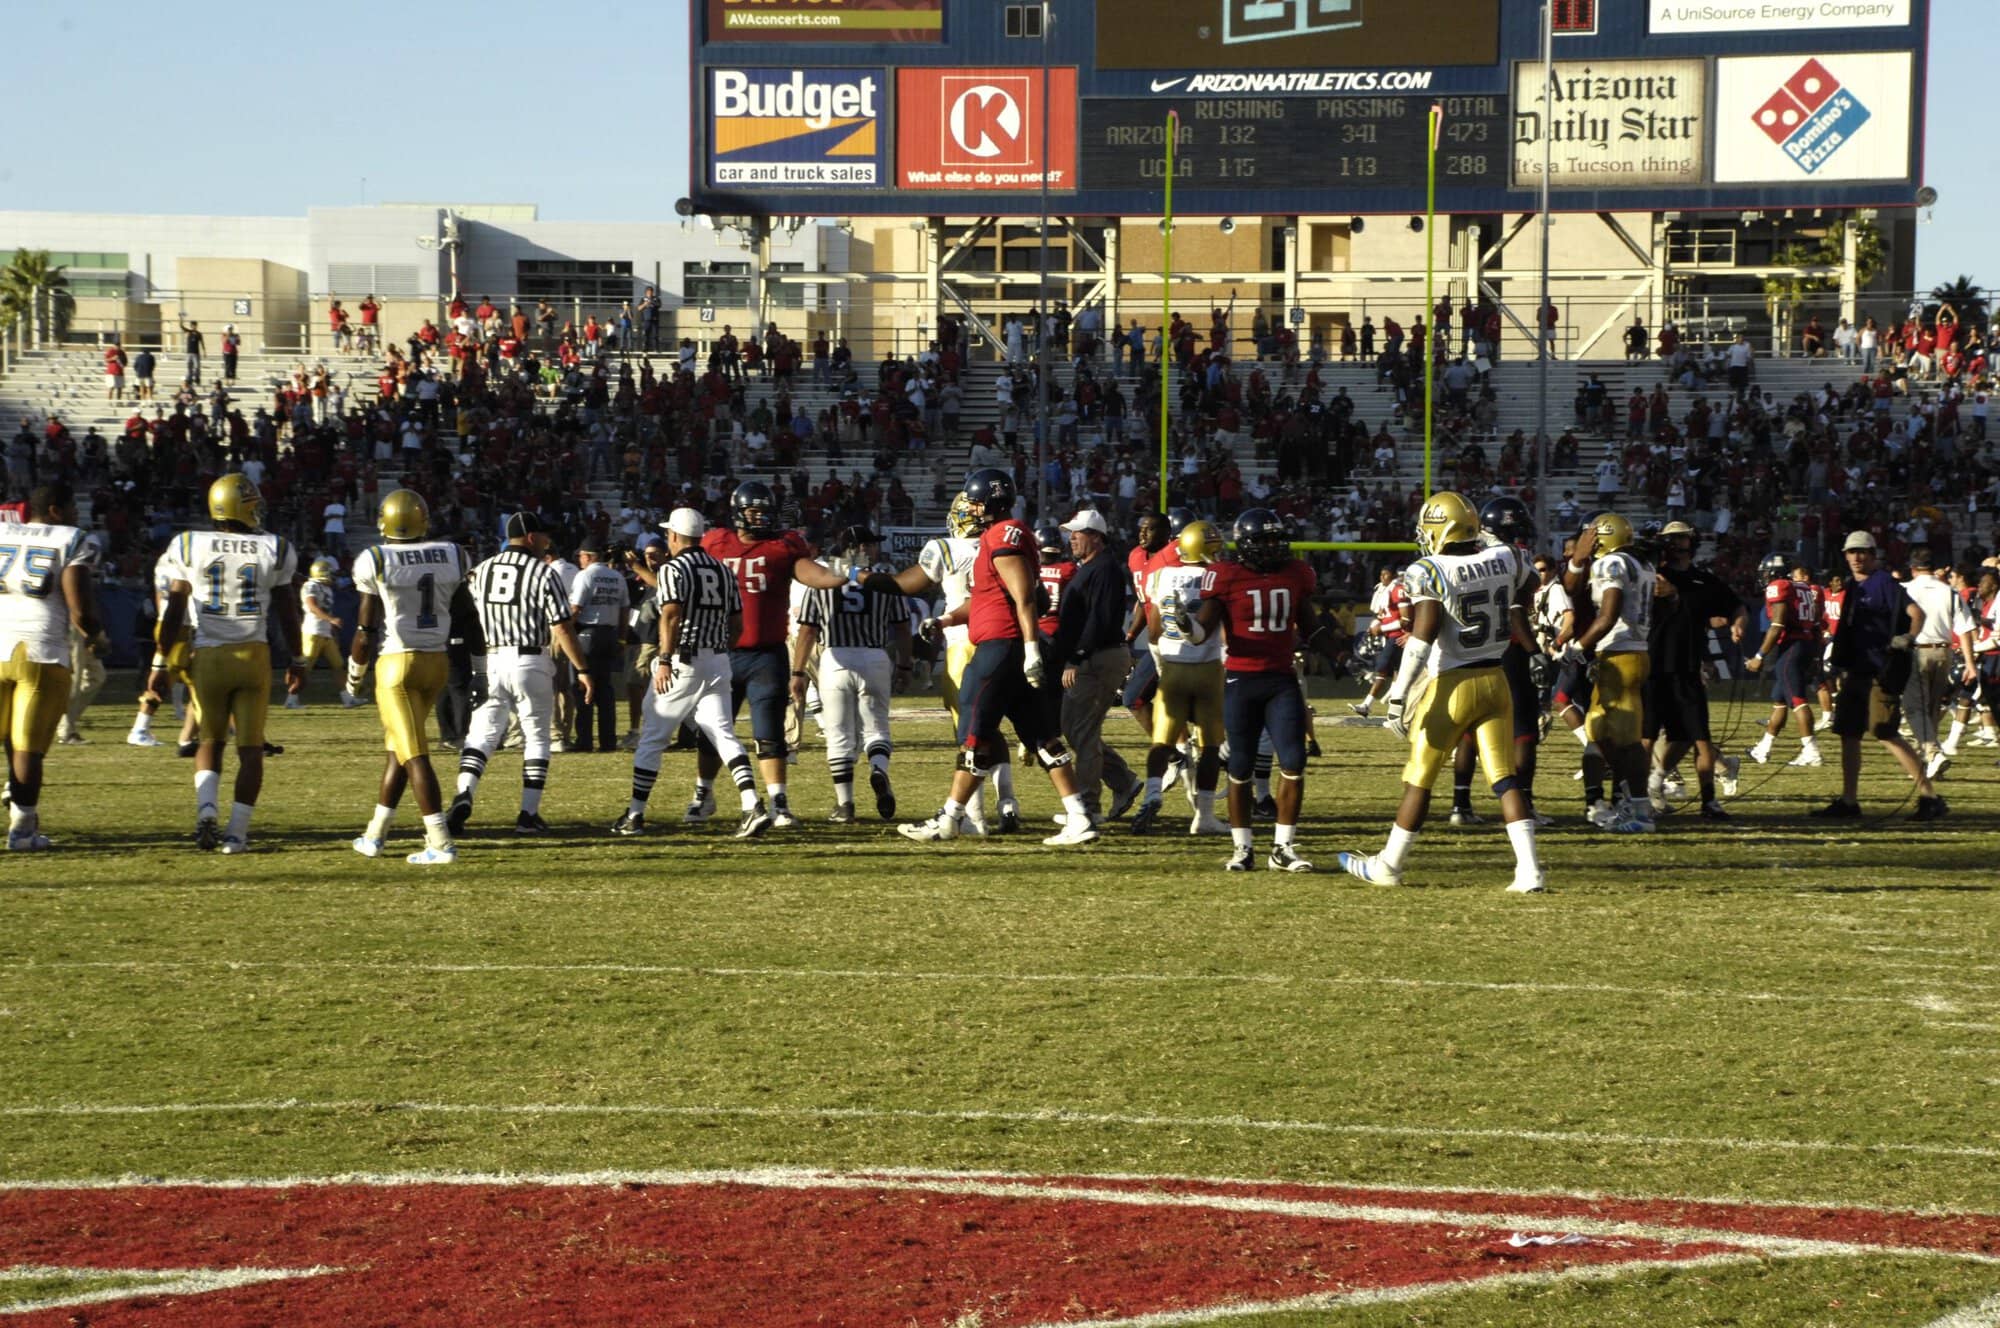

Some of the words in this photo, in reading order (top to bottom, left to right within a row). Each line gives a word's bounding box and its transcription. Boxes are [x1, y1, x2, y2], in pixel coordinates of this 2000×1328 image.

[729, 13, 840, 26] AVAconcerts.com
[1661, 9, 1672, 21] A
[1677, 7, 1756, 21] UniSource
[1761, 5, 1814, 22] Energy
[1820, 3, 1894, 18] Company
[1185, 71, 1432, 92] ARIZONAATHLETICS.COM
[1535, 67, 1678, 102] Arizona
[714, 70, 877, 129] Budget
[1194, 100, 1285, 119] RUSHING
[1316, 98, 1405, 118] PASSING
[1218, 125, 1256, 145] 132
[1341, 124, 1377, 144] 341
[1447, 122, 1488, 142] 473
[1514, 108, 1611, 150] Daily
[1618, 107, 1699, 142] Star
[1784, 97, 1852, 159] Domino's
[1798, 131, 1843, 171] Pizza
[719, 168, 743, 181] car
[750, 165, 778, 181] and
[784, 165, 825, 181] truck
[831, 165, 873, 181] sales
[1446, 155, 1488, 175] 288
[1566, 156, 1634, 173] Tucson
[907, 171, 942, 183] What
[944, 171, 972, 183] else
[975, 171, 993, 183] do
[995, 173, 1019, 185] you
[702, 308, 713, 321] 27
[211, 539, 258, 554] KEYES
[396, 549, 449, 567] VERNER
[722, 556, 768, 594] 75
[1457, 557, 1509, 583] CARTER
[202, 561, 262, 617] 11
[488, 564, 519, 603] B
[697, 568, 723, 606] R
[416, 572, 439, 629] 1
[1247, 588, 1291, 633] 10
[1457, 584, 1512, 650] 51
